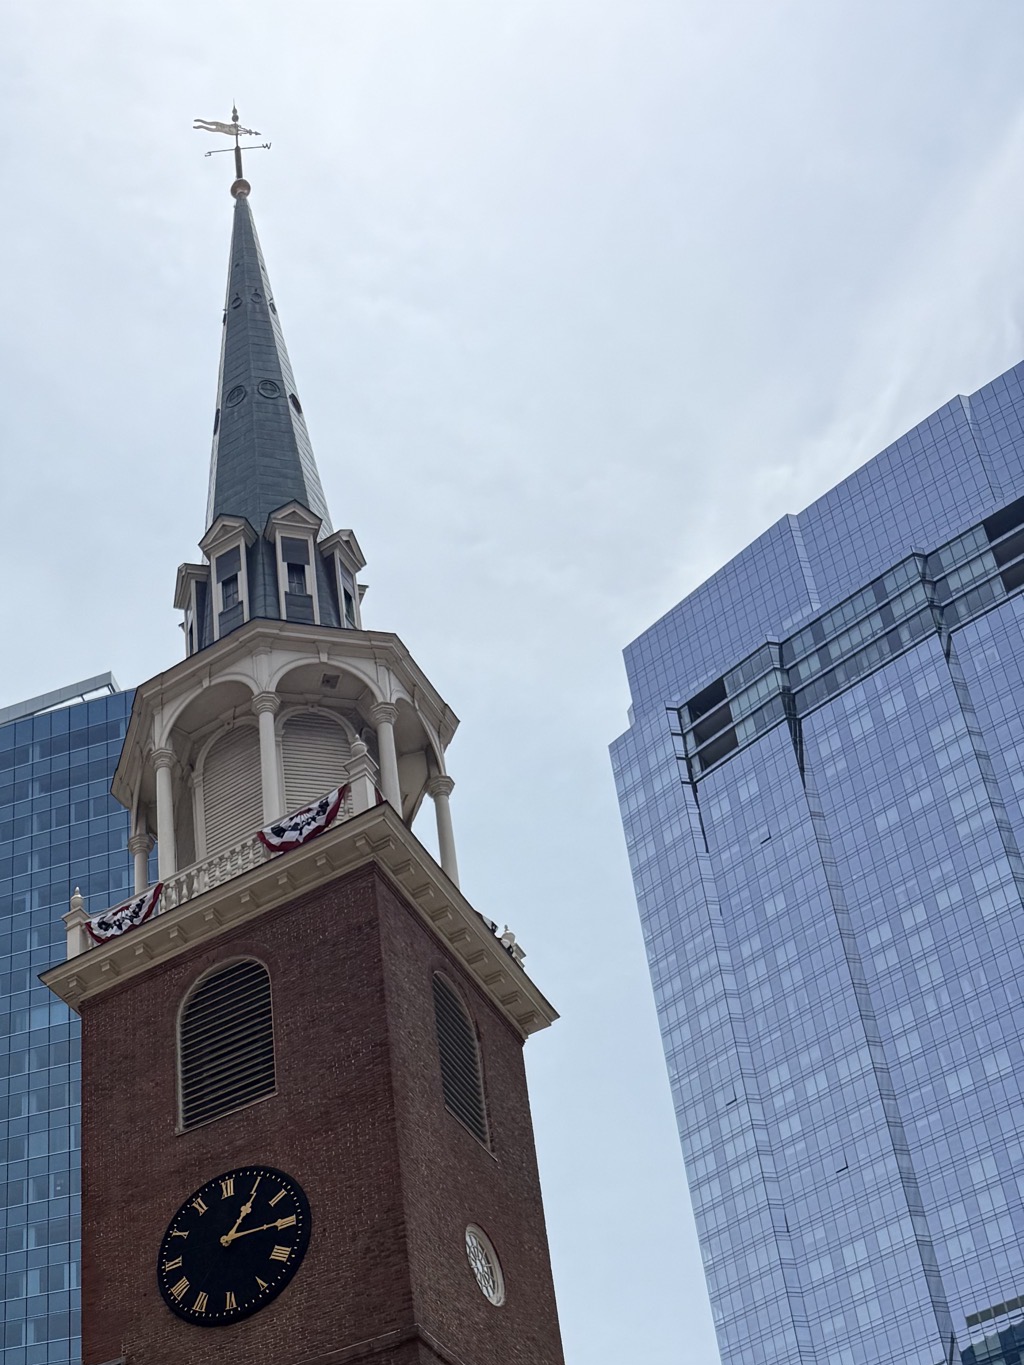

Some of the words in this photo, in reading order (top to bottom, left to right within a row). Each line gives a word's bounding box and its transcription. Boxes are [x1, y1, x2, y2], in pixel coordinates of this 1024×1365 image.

[221, 1179, 235, 1200] XII
[269, 1189, 288, 1207] II
[192, 1198, 209, 1216] XI
[172, 1229, 189, 1239] X
